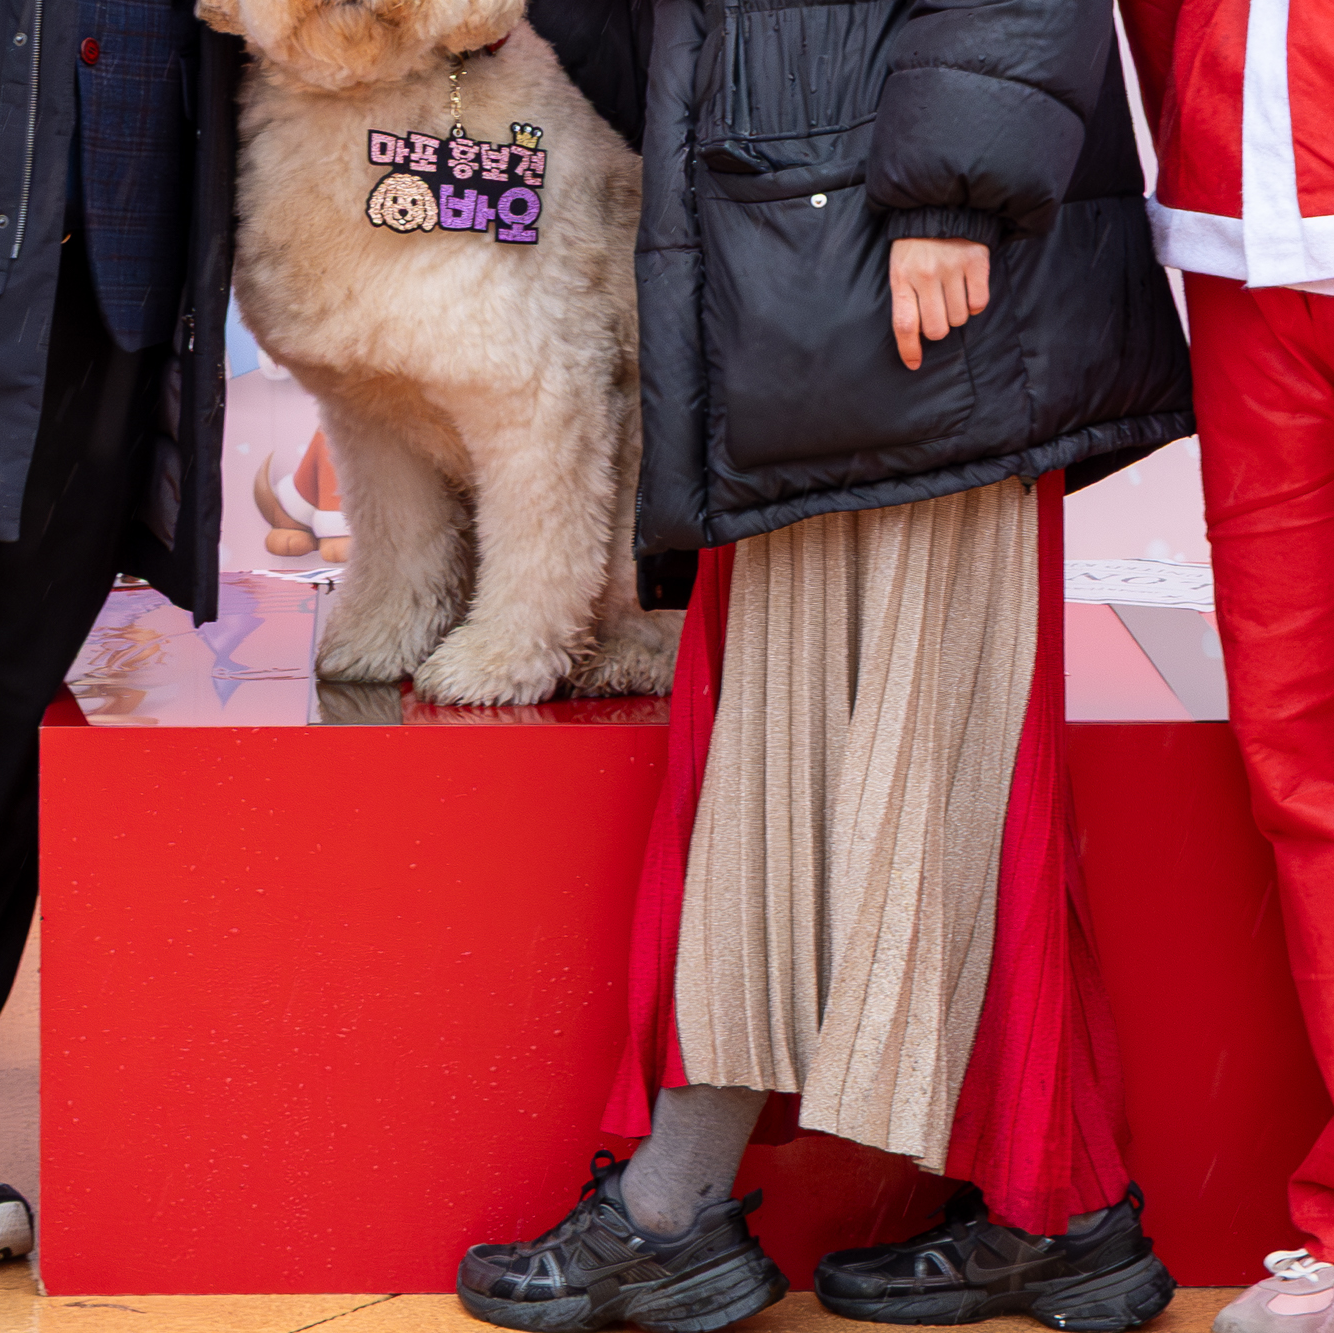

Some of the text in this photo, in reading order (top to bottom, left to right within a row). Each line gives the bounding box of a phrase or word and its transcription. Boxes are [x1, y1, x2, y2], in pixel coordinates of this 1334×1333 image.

[370, 132, 545, 186] 마포 홍보견
[439, 184, 541, 242] 바오
